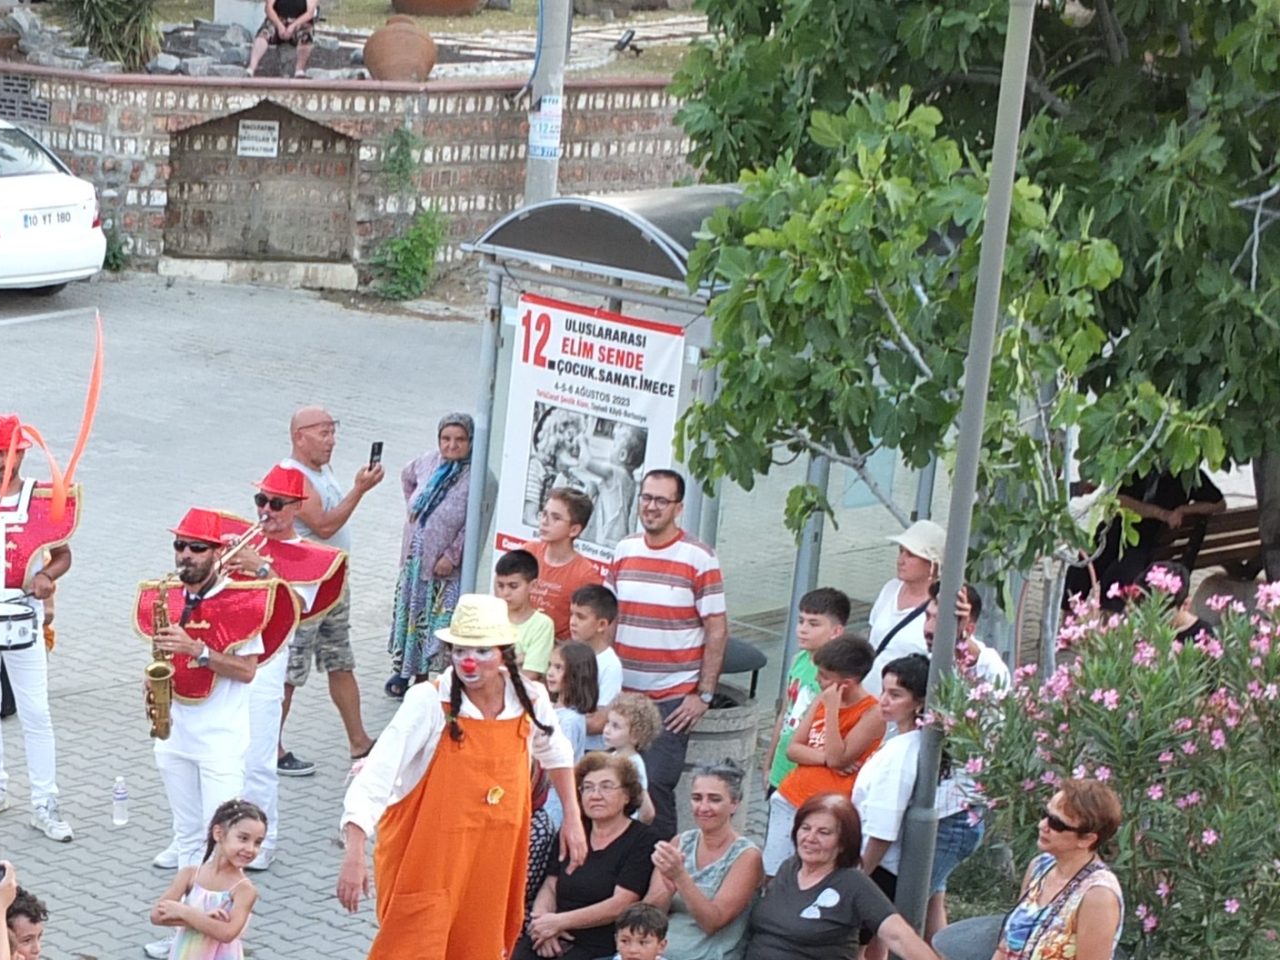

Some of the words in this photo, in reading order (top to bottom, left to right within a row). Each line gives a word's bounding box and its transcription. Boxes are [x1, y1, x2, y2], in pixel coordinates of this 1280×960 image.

[28, 215, 38, 226] 10
[42, 213, 52, 224] YT
[565, 317, 647, 348] ULUSLARARASI
[561, 336, 594, 360] ELİM
[597, 346, 644, 371] SENDE
[575, 385, 610, 403] AĞUSTOS
[612, 395, 631, 407] 2023
